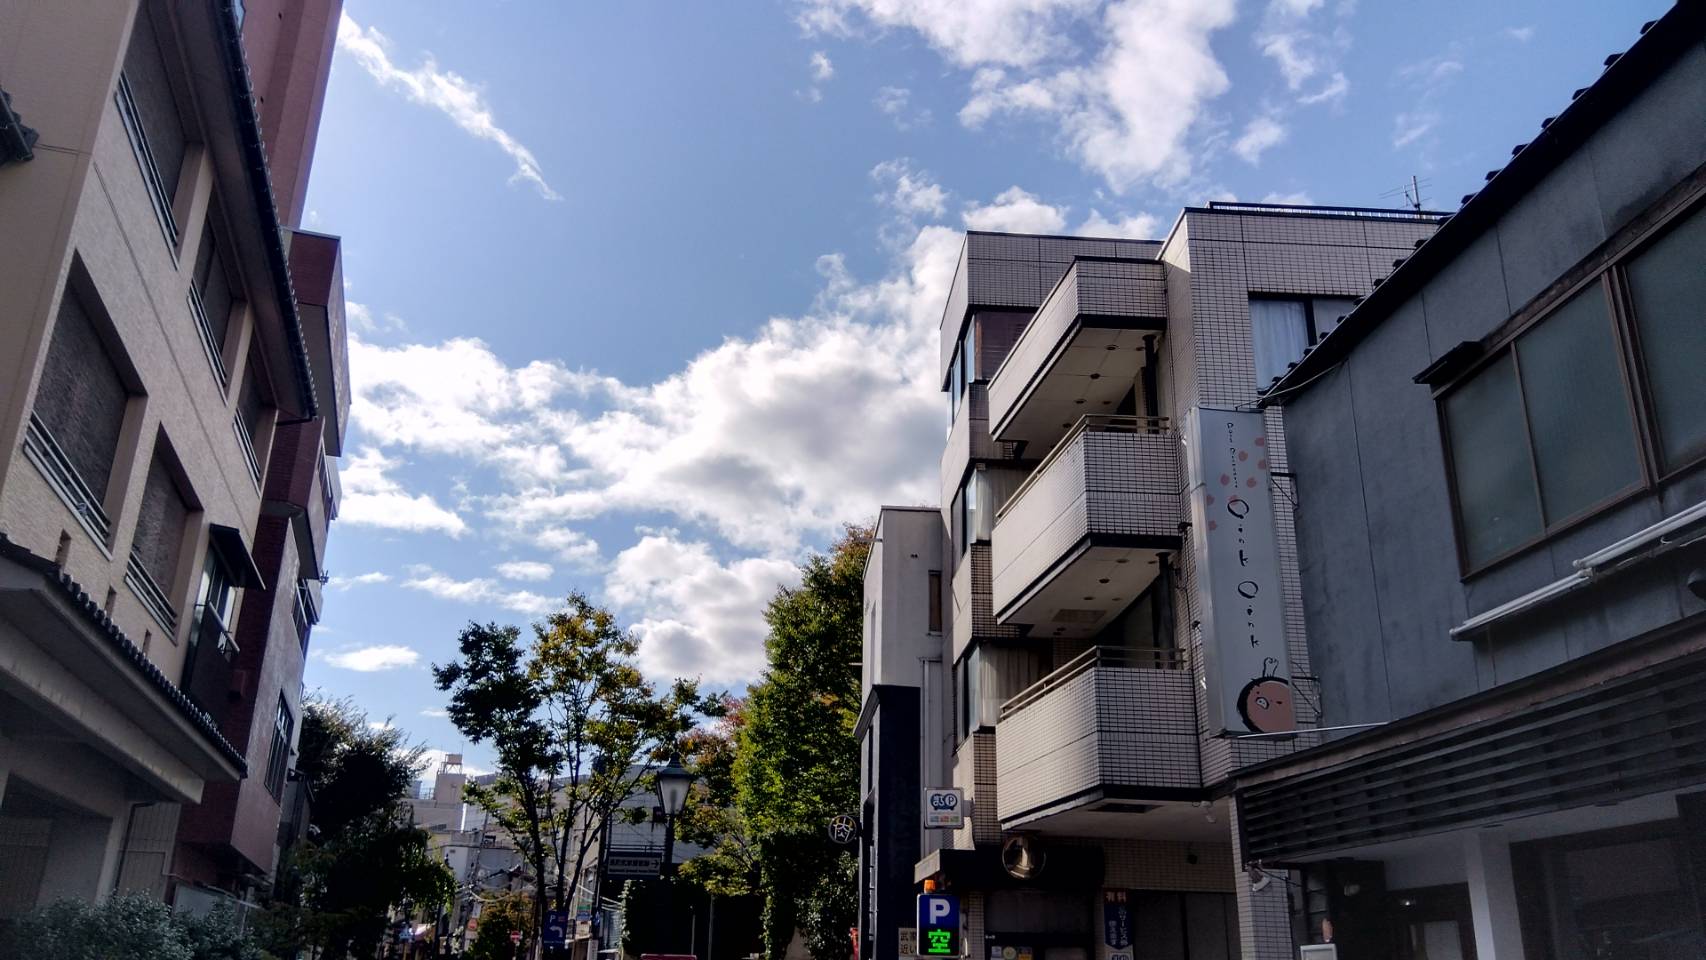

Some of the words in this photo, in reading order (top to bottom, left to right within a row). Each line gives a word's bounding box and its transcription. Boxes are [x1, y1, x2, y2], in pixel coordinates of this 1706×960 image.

[1227, 498, 1250, 566] Oink
[1237, 580, 1259, 649] Oink
[929, 897, 951, 925] P
[928, 928, 951, 953] 空
